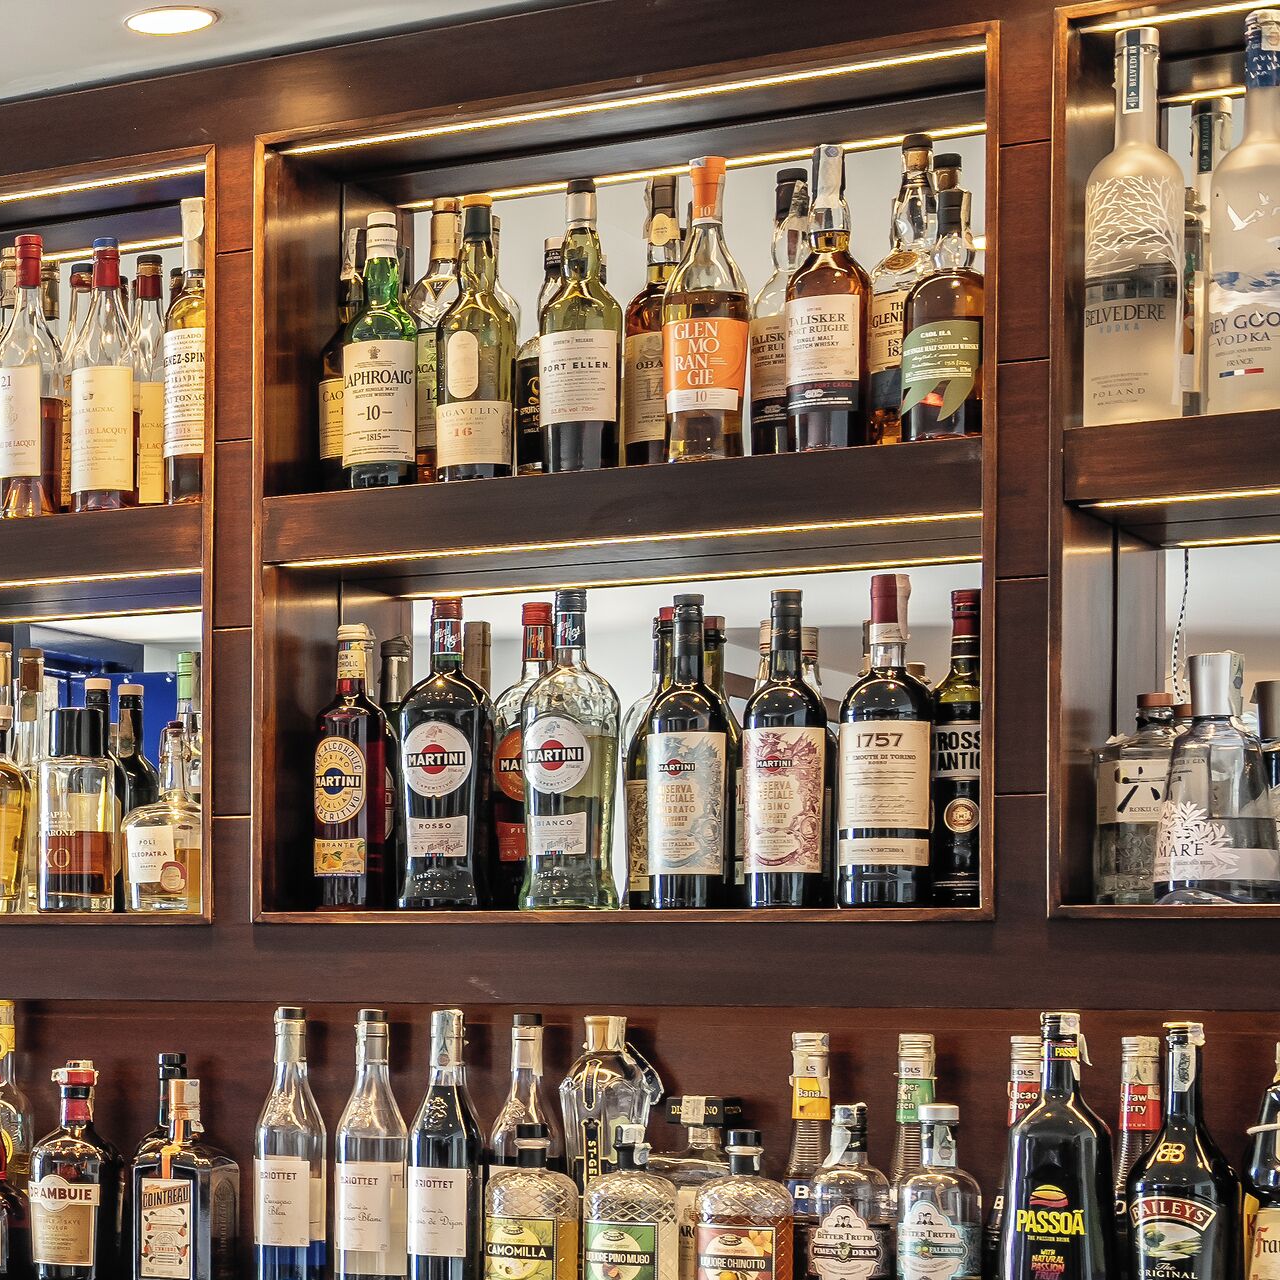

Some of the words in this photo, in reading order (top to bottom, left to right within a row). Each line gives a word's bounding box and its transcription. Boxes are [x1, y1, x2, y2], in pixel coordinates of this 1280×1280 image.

[700, 206, 711, 217] 10
[789, 313, 845, 328] TALISKER
[1085, 304, 1166, 328] BELVEDERE
[674, 322, 719, 339] GLEN
[808, 324, 849, 334] RUIGHE
[815, 340, 839, 348] WHISKY
[1216, 332, 1271, 348] VODKA
[689, 338, 720, 354] MO
[544, 362, 566, 373] PORT
[573, 361, 609, 372] ELLEN
[636, 361, 663, 370] OBA
[675, 354, 708, 372] RAN
[1226, 357, 1254, 367] FRANCE
[1, 376, 11, 387] 21
[345, 369, 413, 390] LAPHROAIG
[687, 368, 714, 385] GIE
[323, 390, 343, 402] CAO
[695, 390, 707, 403] 10
[1093, 387, 1146, 399] POLAND
[366, 405, 380, 421] 10
[96, 427, 127, 435] LACQUY
[454, 427, 473, 437] 16
[367, 433, 382, 441] 1815
[14, 440, 36, 448] LACQUY
[857, 732, 903, 747] 1757
[937, 731, 981, 750] ROSS
[408, 753, 464, 766] MARTINI
[528, 748, 584, 763] MARTINI
[658, 763, 695, 772] MARTINI
[756, 760, 792, 768] MARTINI
[937, 752, 981, 772] ANTIC
[315, 775, 360, 788] MARTINI
[537, 819, 573, 827] BIANCO
[1159, 843, 1204, 857] MARE
[41, 847, 70, 868] XO
[1010, 1090, 1038, 1101] Cacao
[261, 1172, 297, 1181] BRIOTTET
[340, 1177, 378, 1186] BRIOTTET
[415, 1180, 454, 1189] BRIOTTET
[31, 1187, 92, 1200] DRAMBUIE
[144, 1187, 188, 1208] COINTREAU
[1132, 1196, 1209, 1223] BAILEYS
[817, 1231, 844, 1242] BITTER
[845, 1232, 873, 1242] TRUTH
[928, 1230, 956, 1239] TRUTH
[487, 1244, 547, 1258] CAMOMILLA
[852, 1248, 877, 1257] DRAM
[1040, 1248, 1055, 1256] WITH
[609, 1253, 626, 1263] PINO
[627, 1254, 650, 1264] MUGO
[1031, 1253, 1064, 1264] NATURAL
[1031, 1262, 1065, 1273] PASSION
[1155, 1262, 1176, 1271] The
[1035, 1271, 1059, 1280] FRUIT
[1137, 1269, 1197, 1280] ORIGINAL
